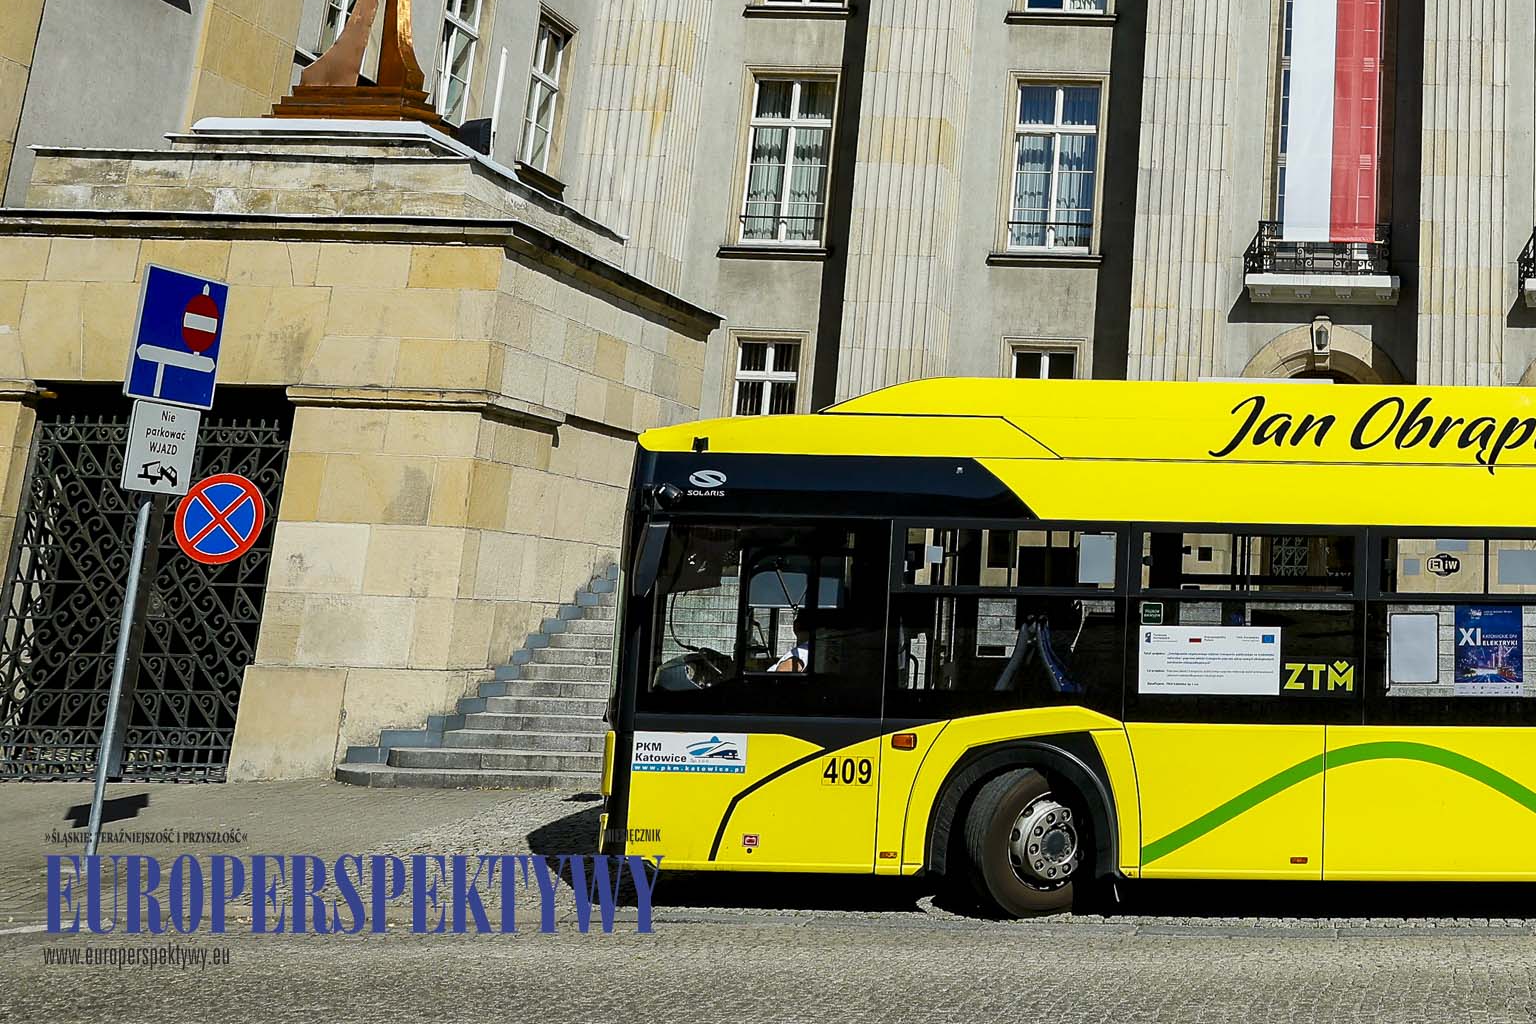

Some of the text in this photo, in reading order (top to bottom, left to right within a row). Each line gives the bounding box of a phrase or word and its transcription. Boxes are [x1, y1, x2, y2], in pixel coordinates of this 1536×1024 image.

[161, 410, 176, 422] Nie
[145, 427, 186, 440] parkować
[1208, 395, 1336, 459] Jan
[149, 441, 178, 455] WJAZD
[687, 489, 725, 497] SOLARIS
[1458, 627, 1482, 646] XI
[1283, 661, 1354, 691] ZTM
[635, 742, 662, 752] PKM
[635, 753, 687, 763] Katowice
[634, 765, 744, 773] www.pkm.katowice.pl
[823, 758, 872, 784] 409
